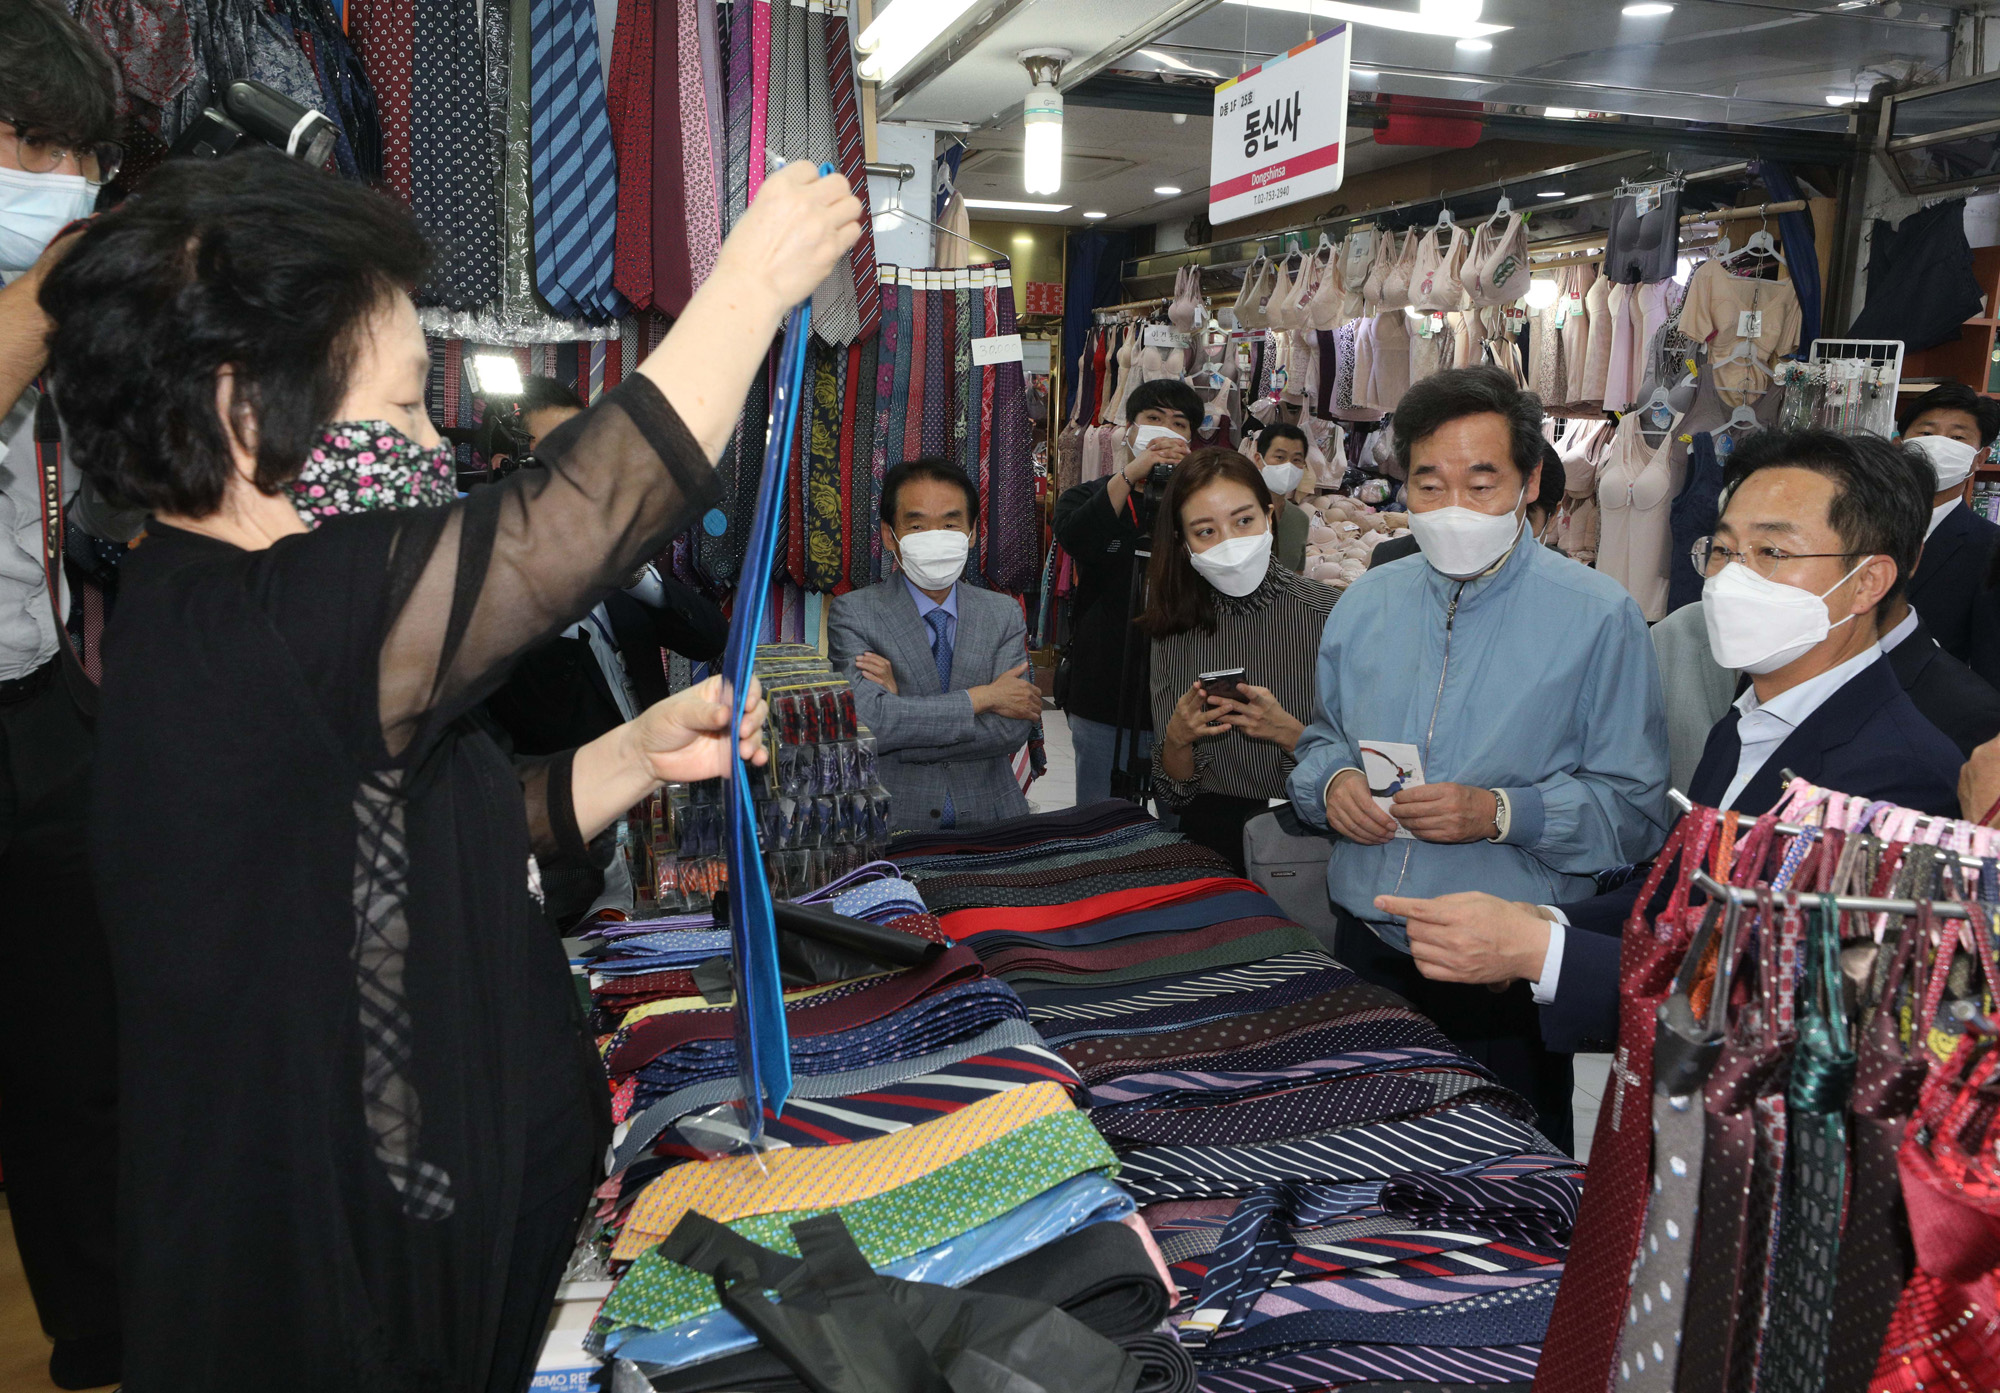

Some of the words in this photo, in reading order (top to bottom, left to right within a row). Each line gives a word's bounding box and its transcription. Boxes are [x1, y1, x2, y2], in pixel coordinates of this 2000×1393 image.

[1220, 102, 1229, 117] D동
[1230, 99, 1237, 112] 1F
[1241, 91, 1253, 108] 25호
[1244, 90, 1301, 158] 동신사
[1251, 165, 1286, 186] Dongshinsa
[1253, 185, 1290, 205] T.02-753-2940
[531, 1373, 567, 1387] MEMO
